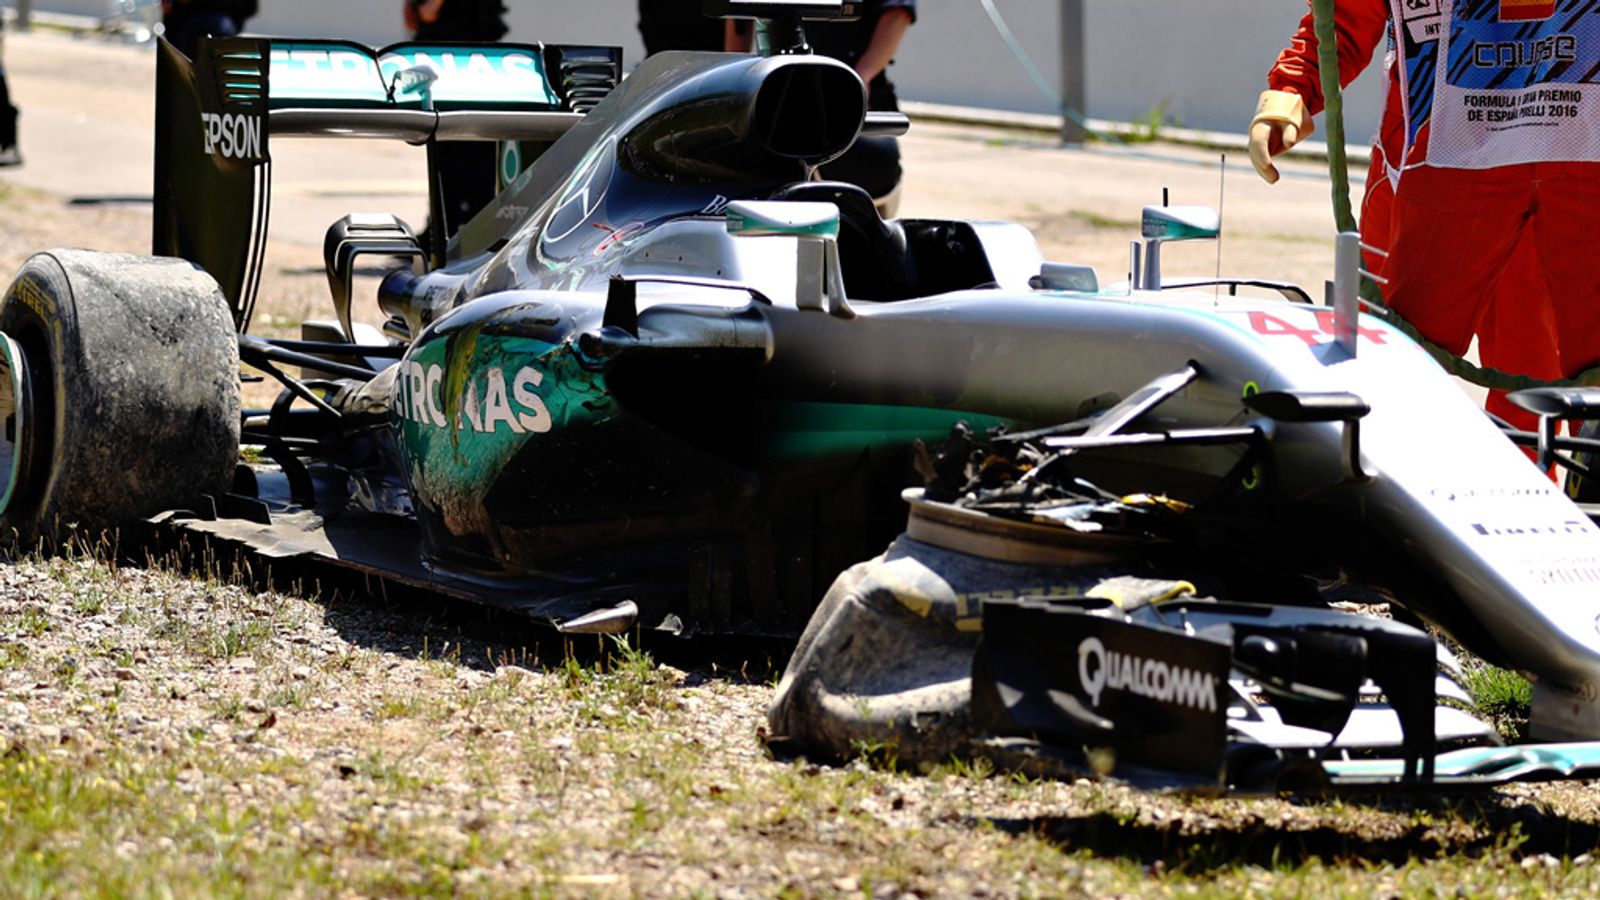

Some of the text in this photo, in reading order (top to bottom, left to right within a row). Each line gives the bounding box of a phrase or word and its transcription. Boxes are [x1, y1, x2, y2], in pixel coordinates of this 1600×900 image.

[1463, 95, 1515, 108] FORMULA
[1539, 90, 1582, 102] PREMIO
[1468, 109, 1483, 121] DE
[1548, 105, 1578, 117] 2016
[201, 112, 262, 158] EPSON
[1078, 637, 1218, 712] QUALCOMM
